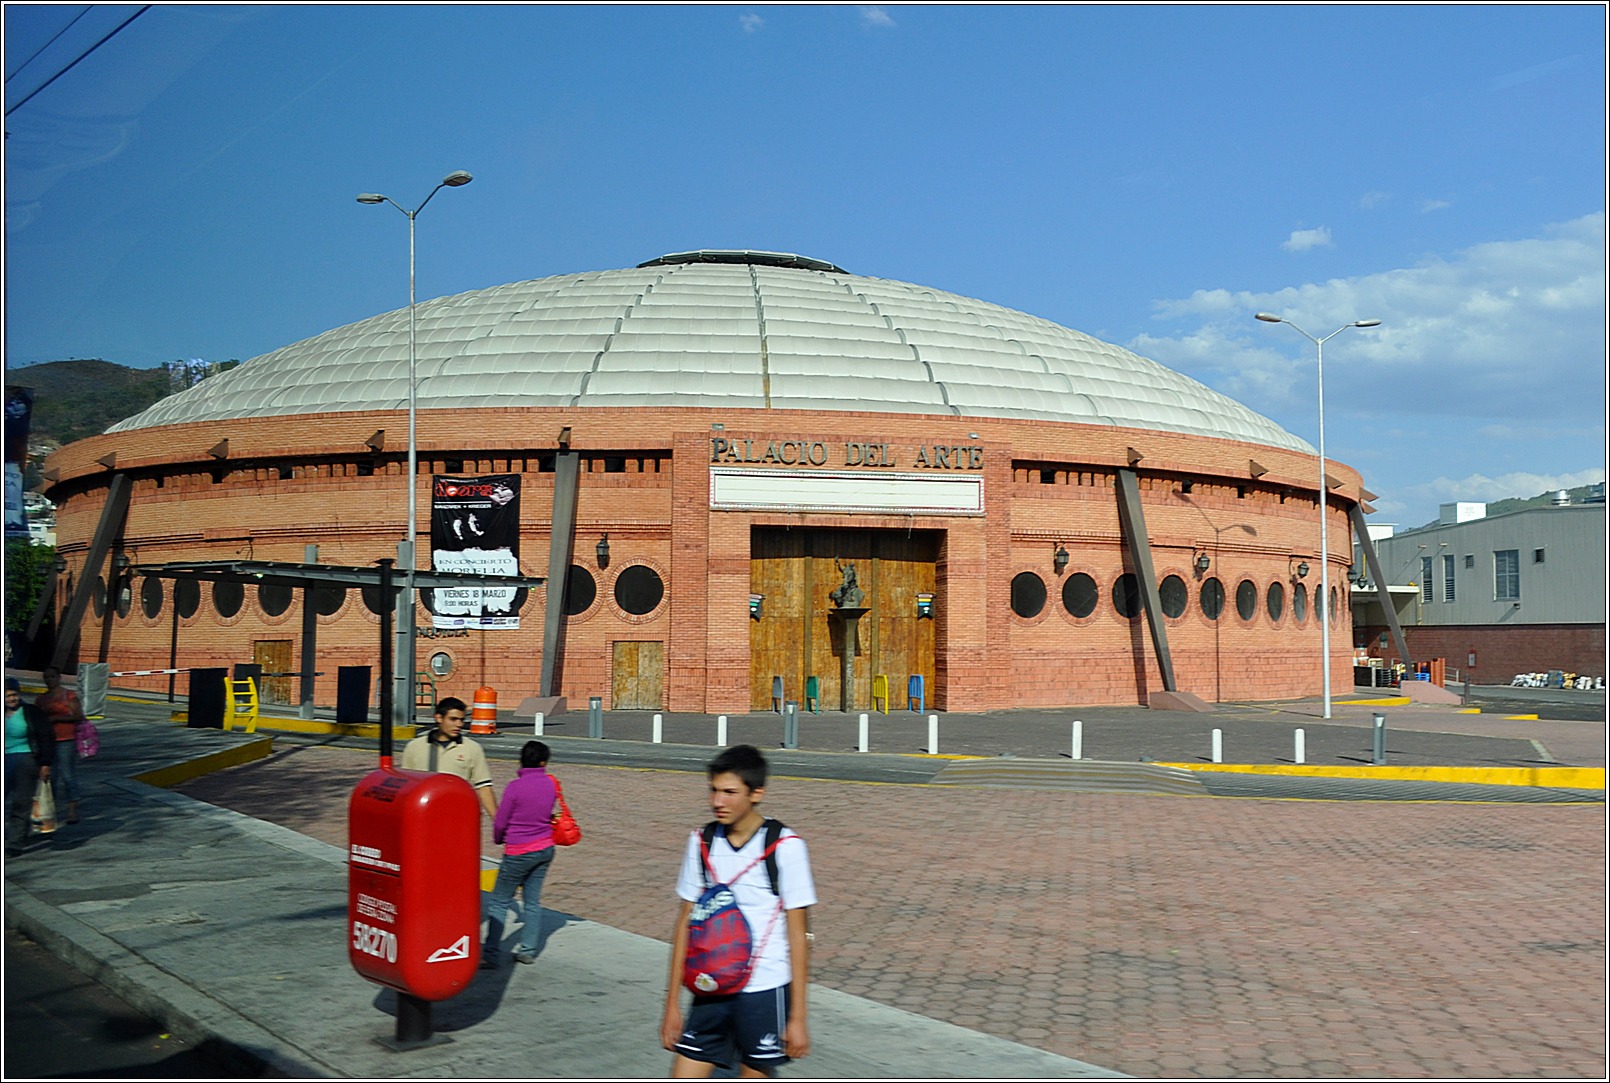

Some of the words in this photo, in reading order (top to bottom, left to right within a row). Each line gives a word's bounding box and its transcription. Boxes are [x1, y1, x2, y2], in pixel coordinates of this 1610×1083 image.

[711, 438, 828, 466] PALACIO
[845, 442, 895, 467] DEL
[913, 445, 984, 470] ARTE
[444, 589, 469, 598] VIERNES
[473, 589, 480, 598] 18
[482, 589, 507, 598] MARZO
[353, 921, 397, 963] 58270
